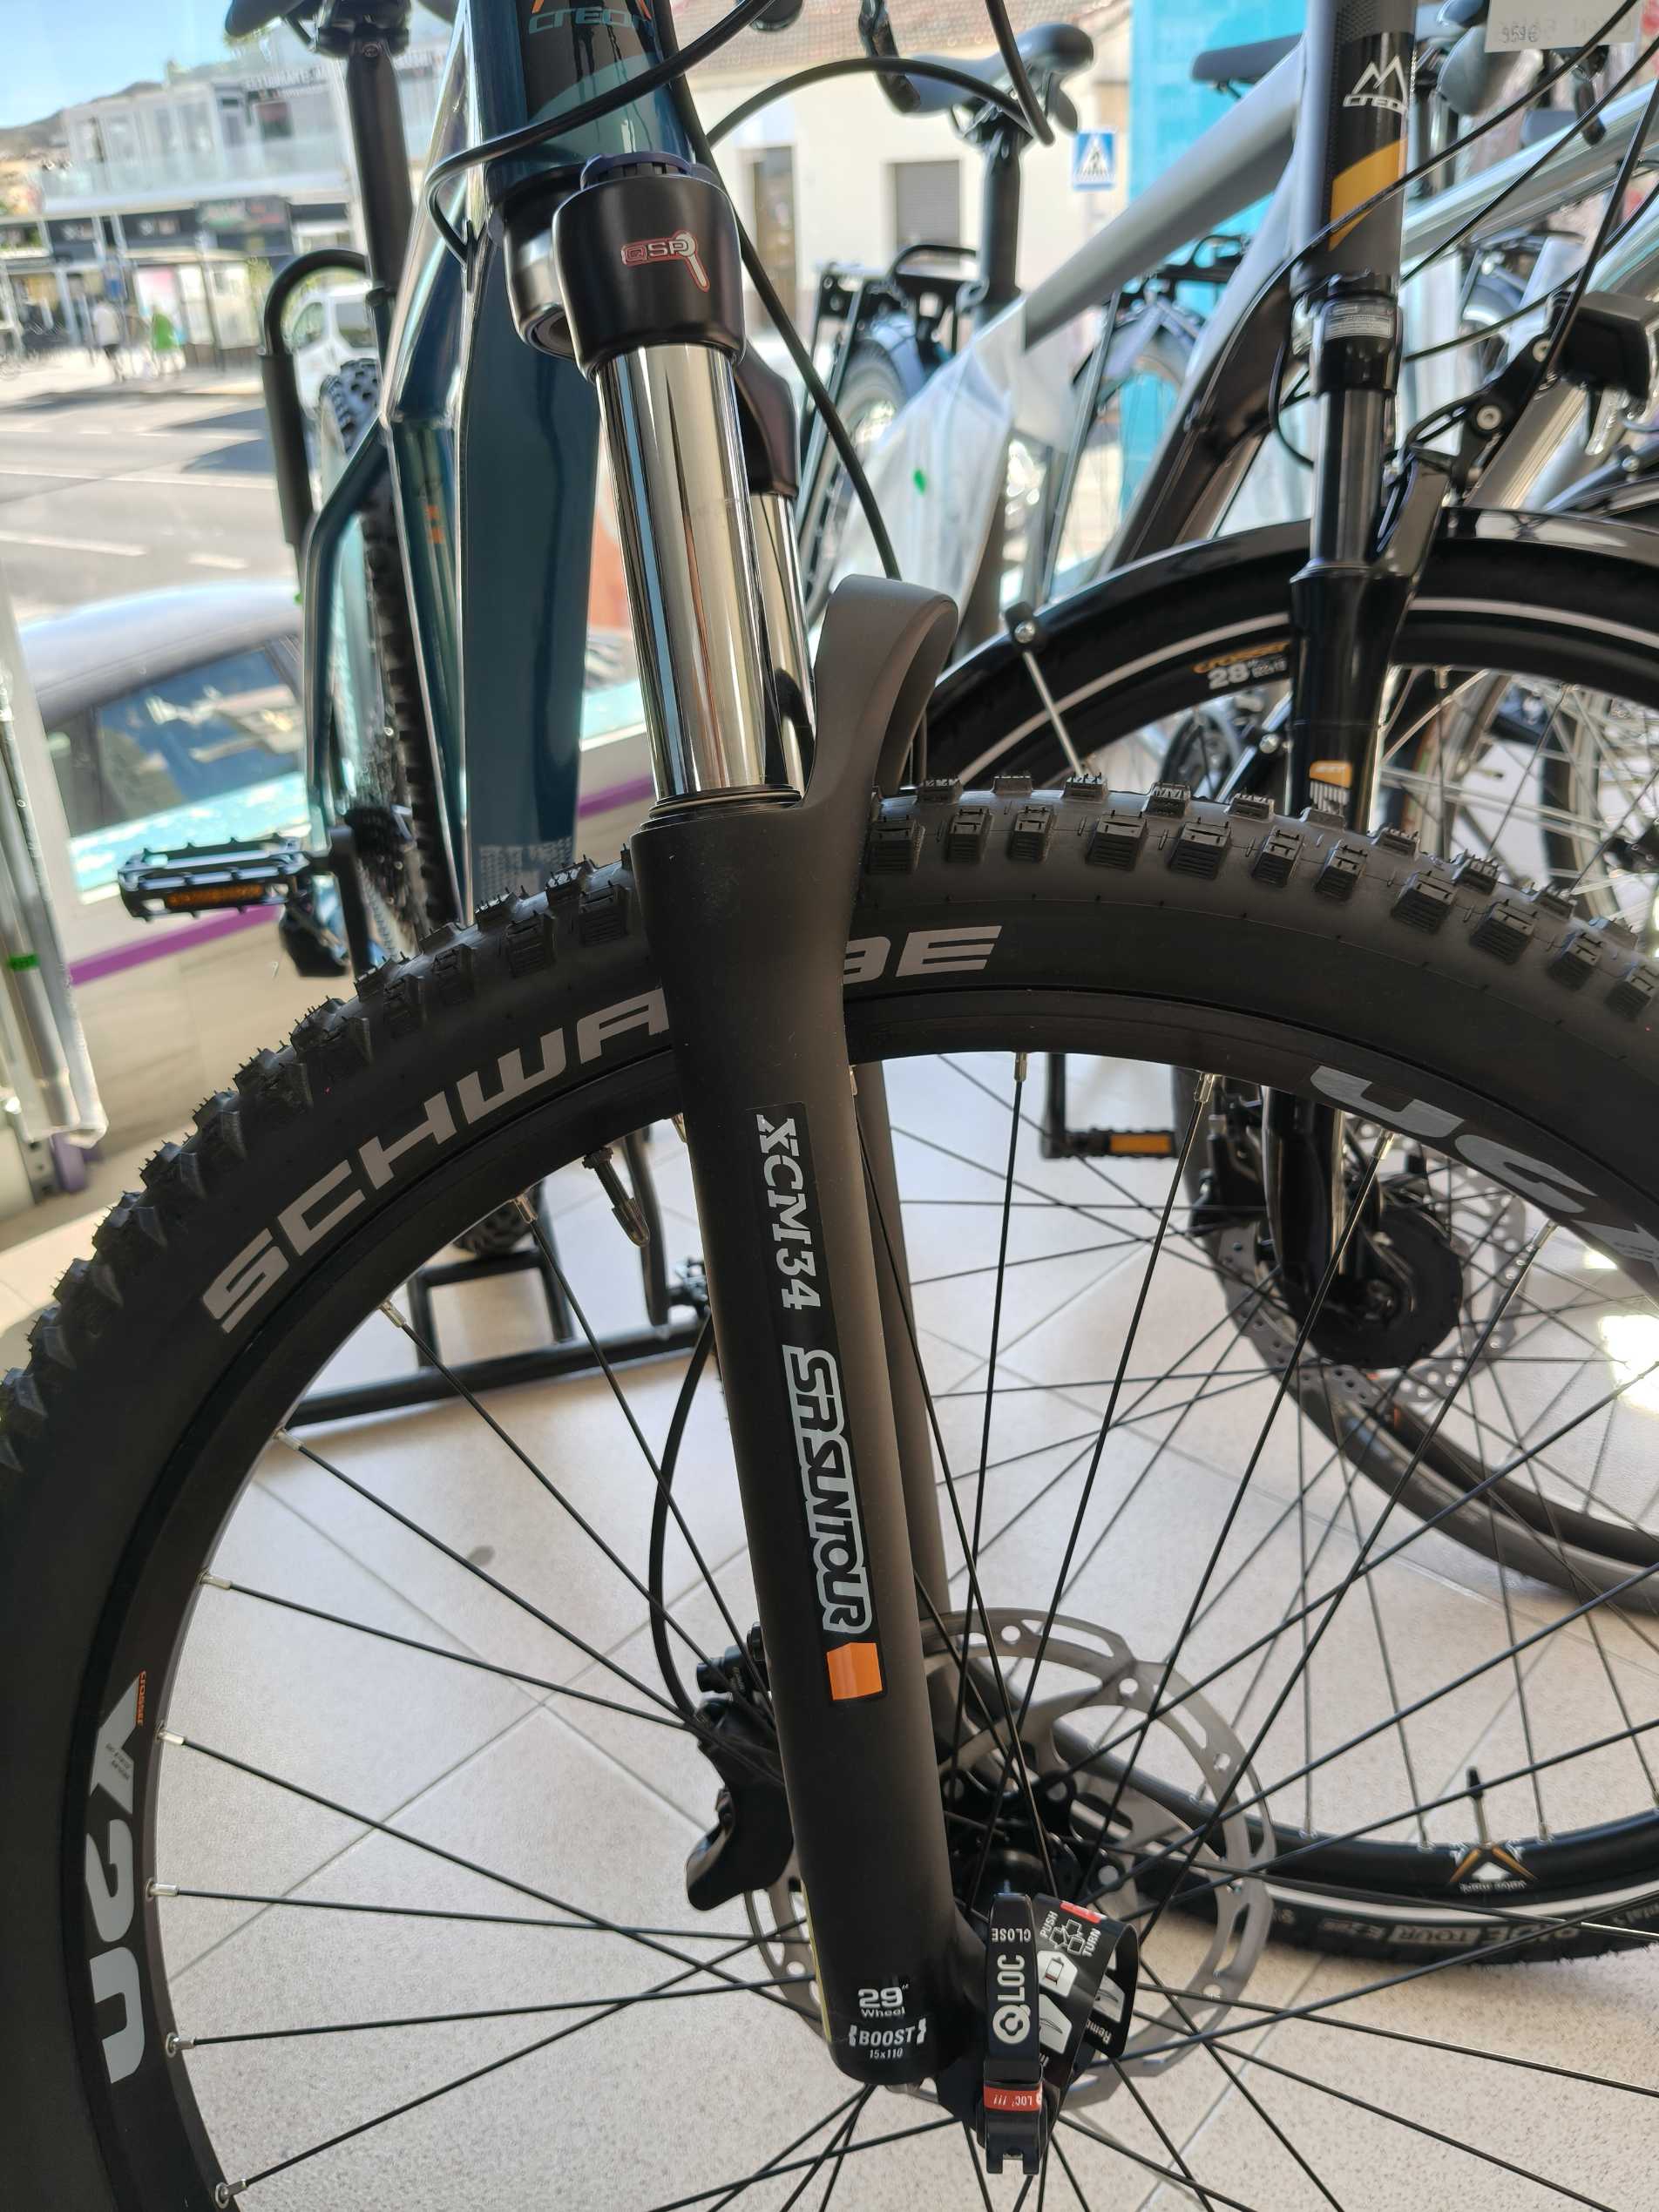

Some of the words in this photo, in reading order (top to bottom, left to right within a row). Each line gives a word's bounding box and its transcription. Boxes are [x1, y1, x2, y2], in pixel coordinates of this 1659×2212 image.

[202, 925, 1002, 1334] SCHWABE
[756, 1114, 821, 1310] XCM34
[992, 1928, 1031, 1943] CLOSE
[1039, 1911, 1059, 1939] PUSH
[1081, 1927, 1101, 1958] TURN
[861, 2006, 905, 2019] Wheel
[870, 2047, 904, 2060] 15x110
